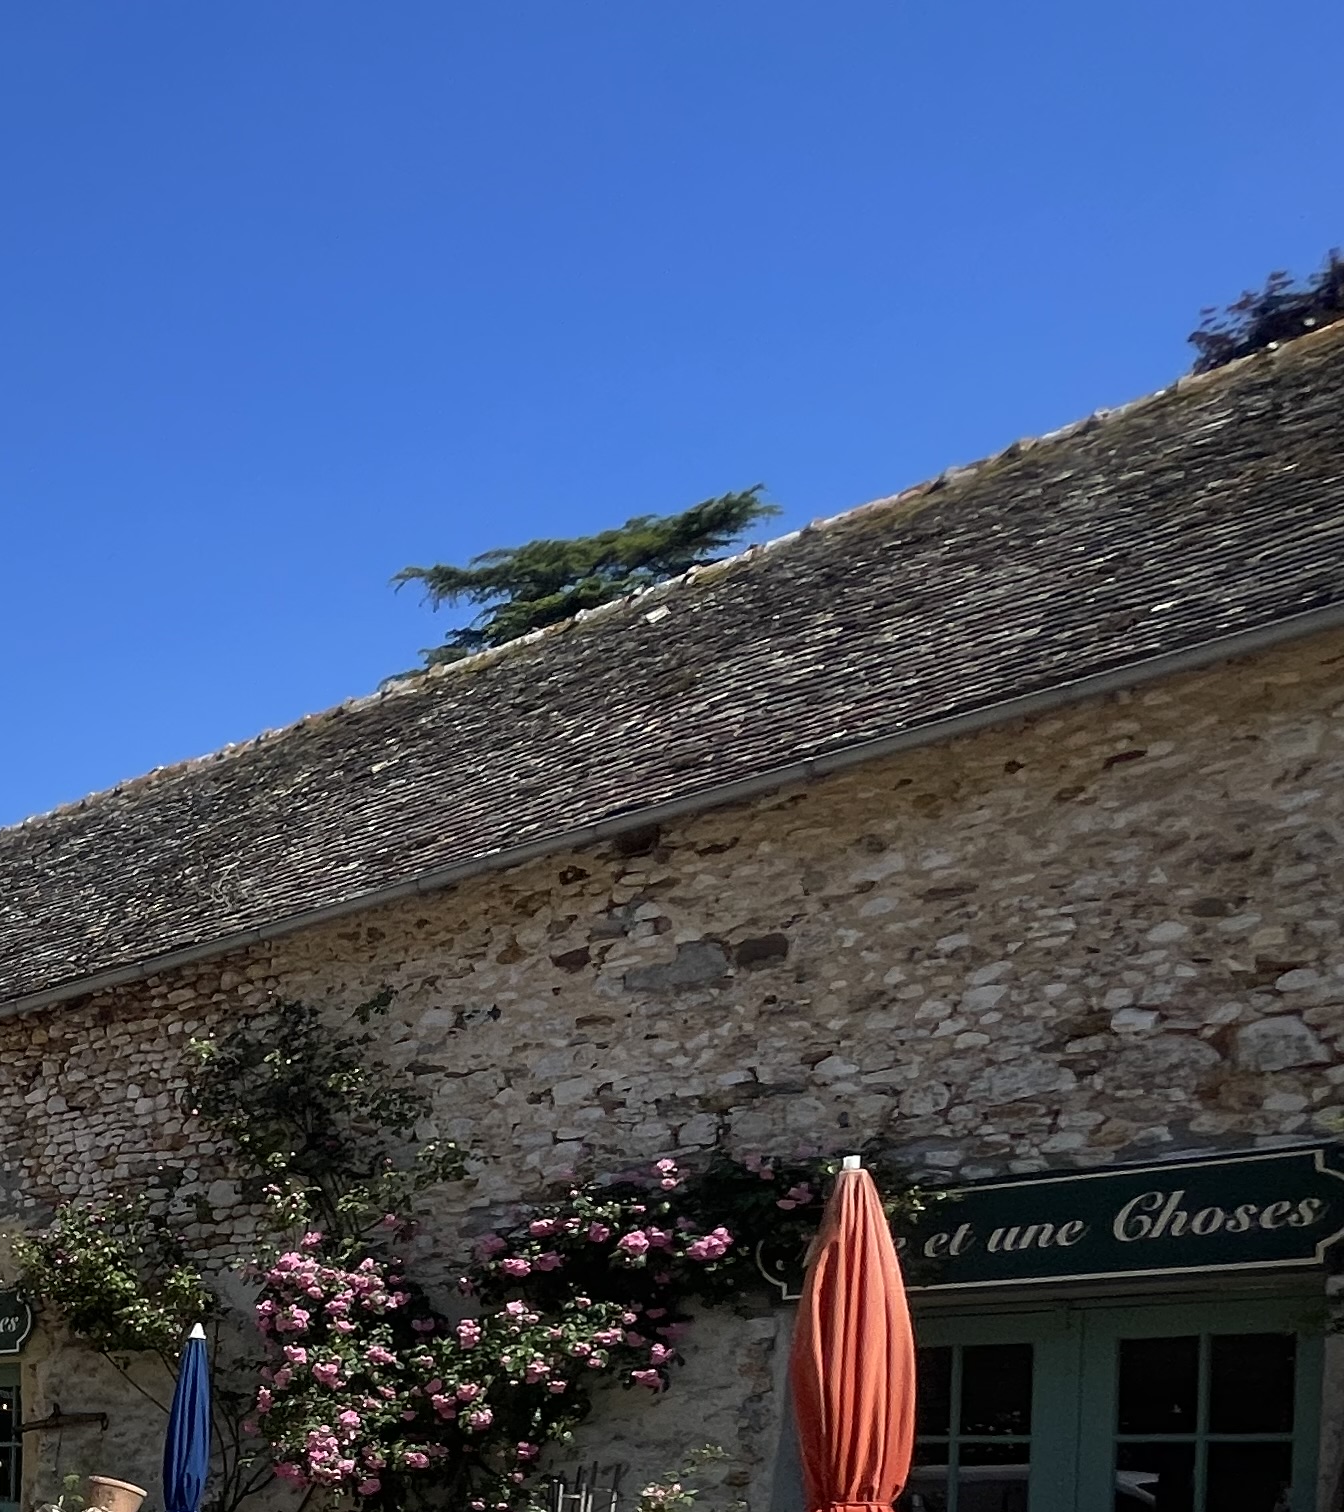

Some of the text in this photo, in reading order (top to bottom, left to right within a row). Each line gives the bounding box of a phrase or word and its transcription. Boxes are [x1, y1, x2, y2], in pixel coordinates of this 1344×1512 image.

[924, 1222, 972, 1258] et
[987, 1220, 1086, 1254] une
[1113, 1190, 1323, 1242] Choses
